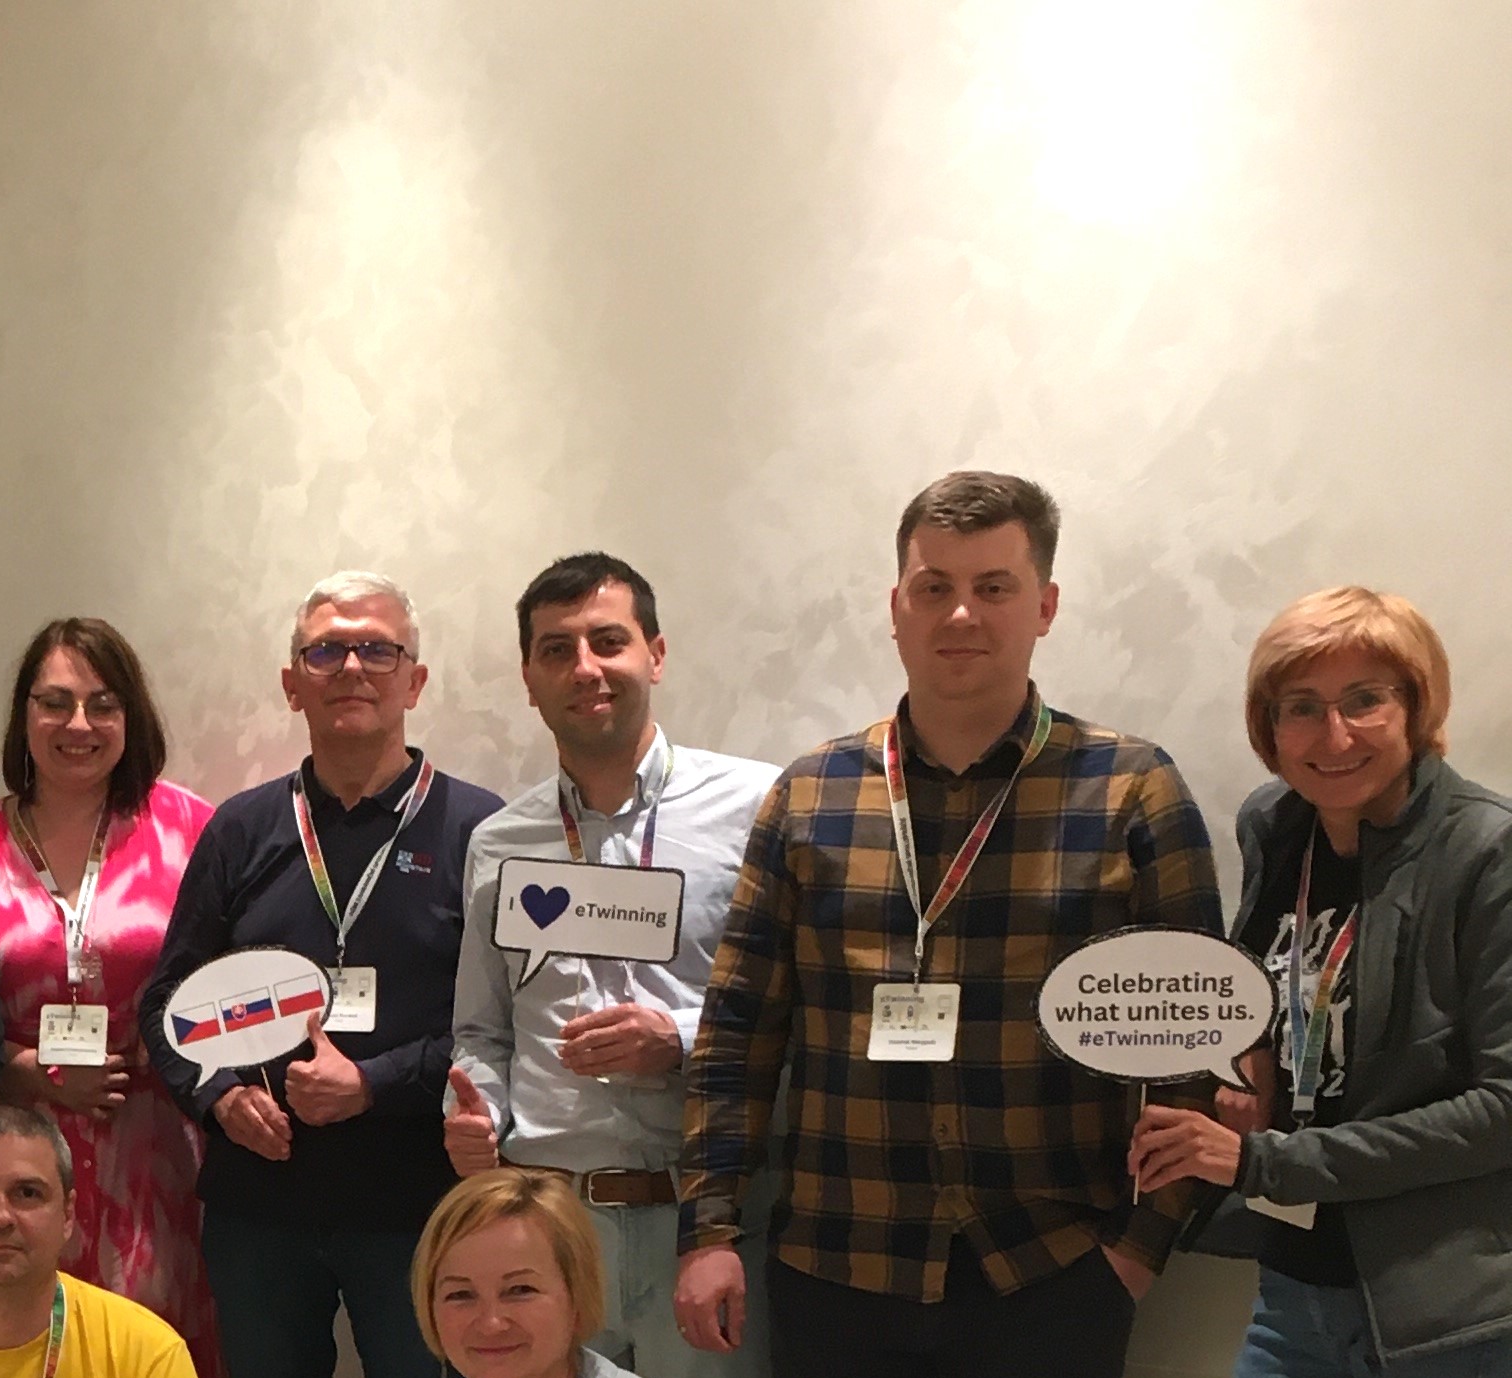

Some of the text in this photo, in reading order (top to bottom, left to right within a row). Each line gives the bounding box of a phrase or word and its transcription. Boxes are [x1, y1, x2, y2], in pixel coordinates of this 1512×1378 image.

[509, 896, 667, 928] I eTwinning
[1078, 972, 1234, 998] Celebrating
[1055, 1000, 1255, 1022] what unites us.
[1078, 1029, 1223, 1050] #eTwinning20
